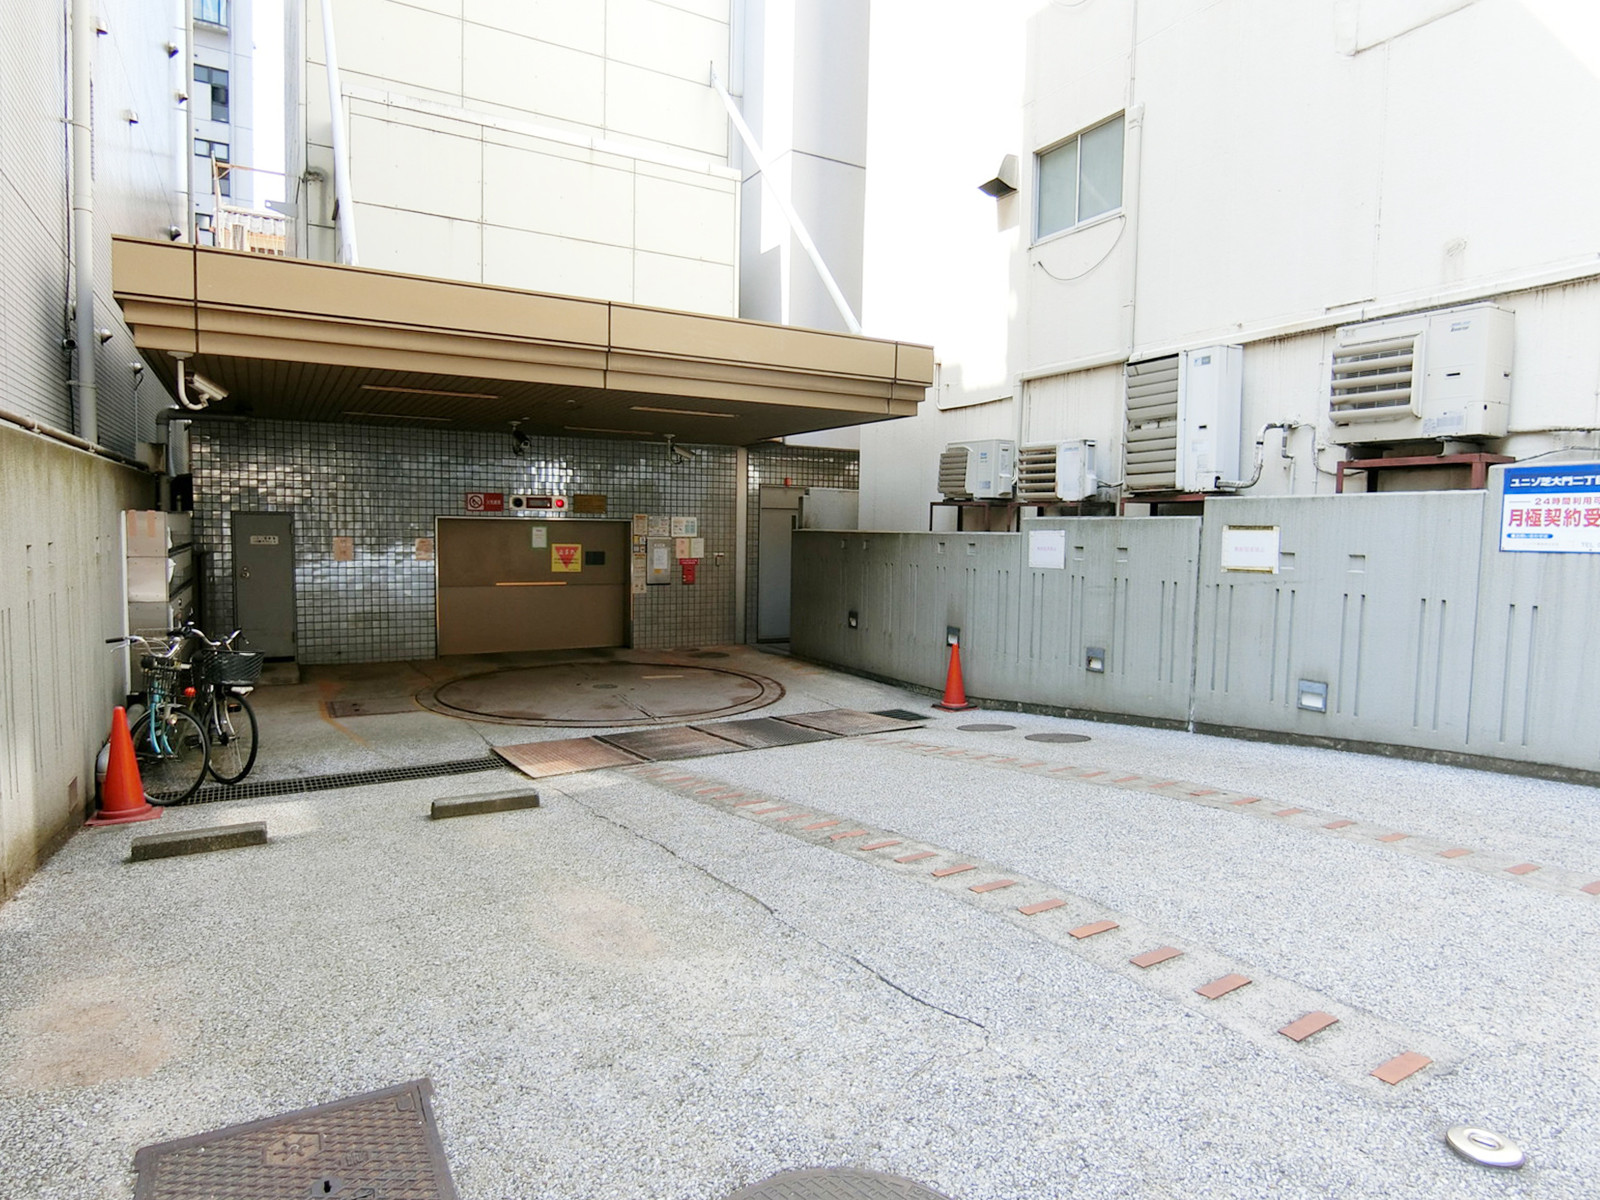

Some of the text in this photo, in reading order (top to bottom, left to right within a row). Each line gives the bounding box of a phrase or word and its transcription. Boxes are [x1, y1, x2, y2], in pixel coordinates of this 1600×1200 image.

[1509, 508, 1600, 527] 月極契約受
